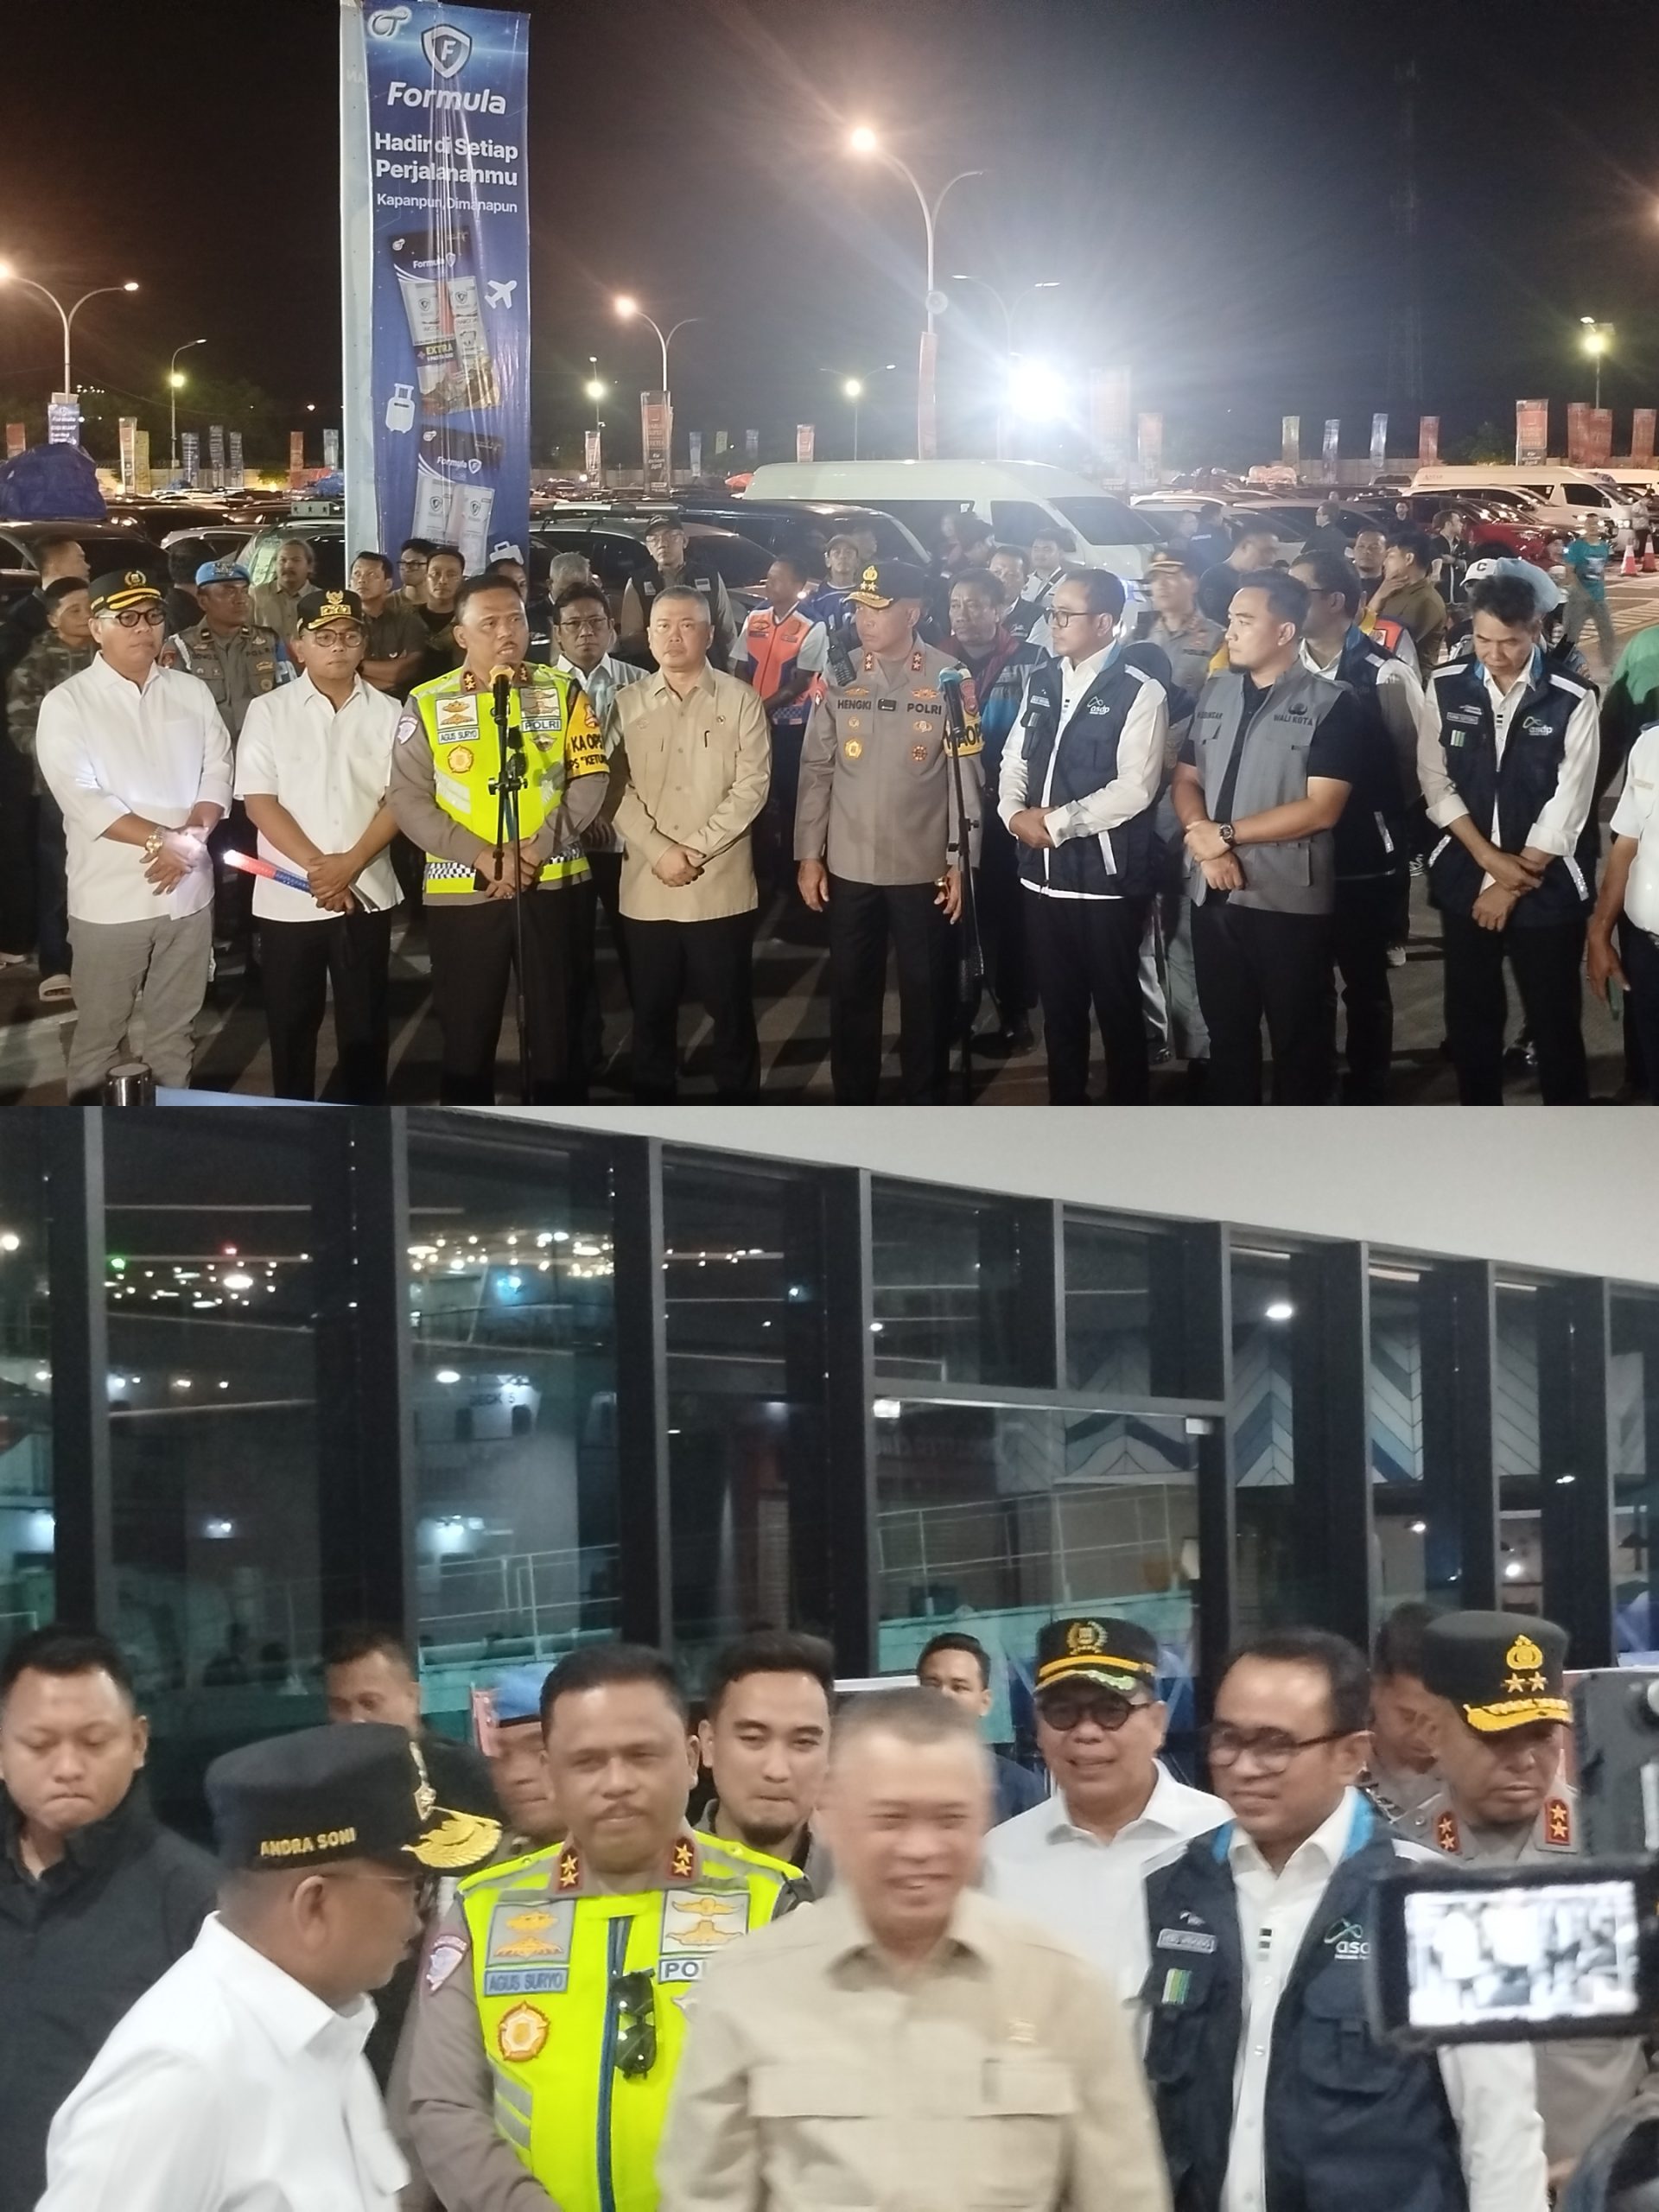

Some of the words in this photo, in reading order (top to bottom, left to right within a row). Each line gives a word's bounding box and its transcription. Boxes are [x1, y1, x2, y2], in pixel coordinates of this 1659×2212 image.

[387, 81, 506, 114] Formula
[375, 131, 431, 153] Hadir
[434, 137, 452, 154] di
[454, 138, 518, 162] Setiap
[376, 159, 518, 186] Perjalananmu
[1477, 563, 1487, 571] C
[837, 699, 872, 710] HENGKI
[906, 702, 942, 715] POLRI
[524, 720, 560, 730] POLRI
[1274, 714, 1290, 722] WALI
[1292, 715, 1313, 726] KOTA
[440, 733, 456, 741] AGUS
[458, 730, 478, 740] SURYO
[261, 1837, 314, 1857] ANDRA
[317, 1827, 356, 1850] SONI
[489, 1974, 520, 1992] AGUS
[524, 1971, 563, 1989] SURYO
